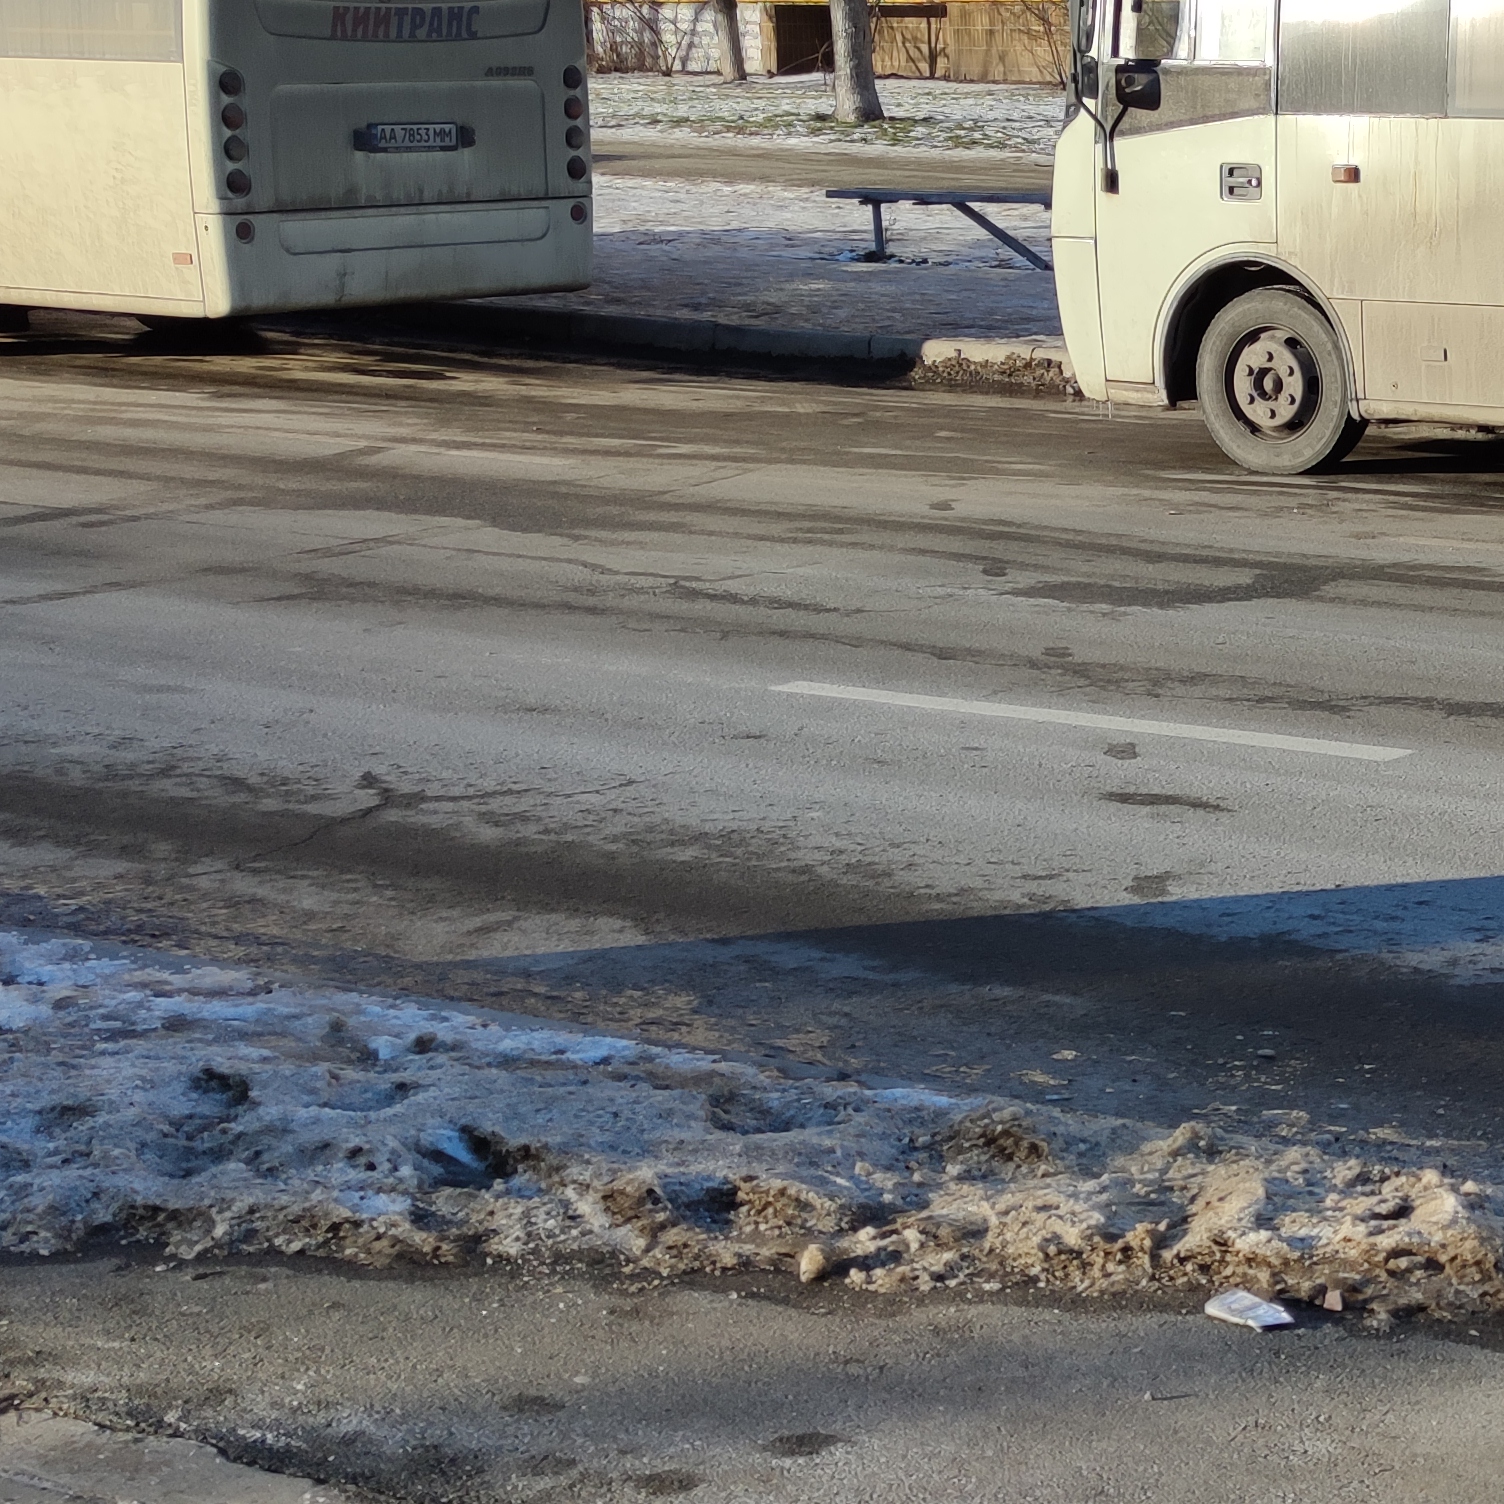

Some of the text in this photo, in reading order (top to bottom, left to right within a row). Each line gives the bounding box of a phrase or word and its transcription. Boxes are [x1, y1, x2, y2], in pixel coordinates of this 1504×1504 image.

[378, 127, 453, 144] AA 7853 MM
